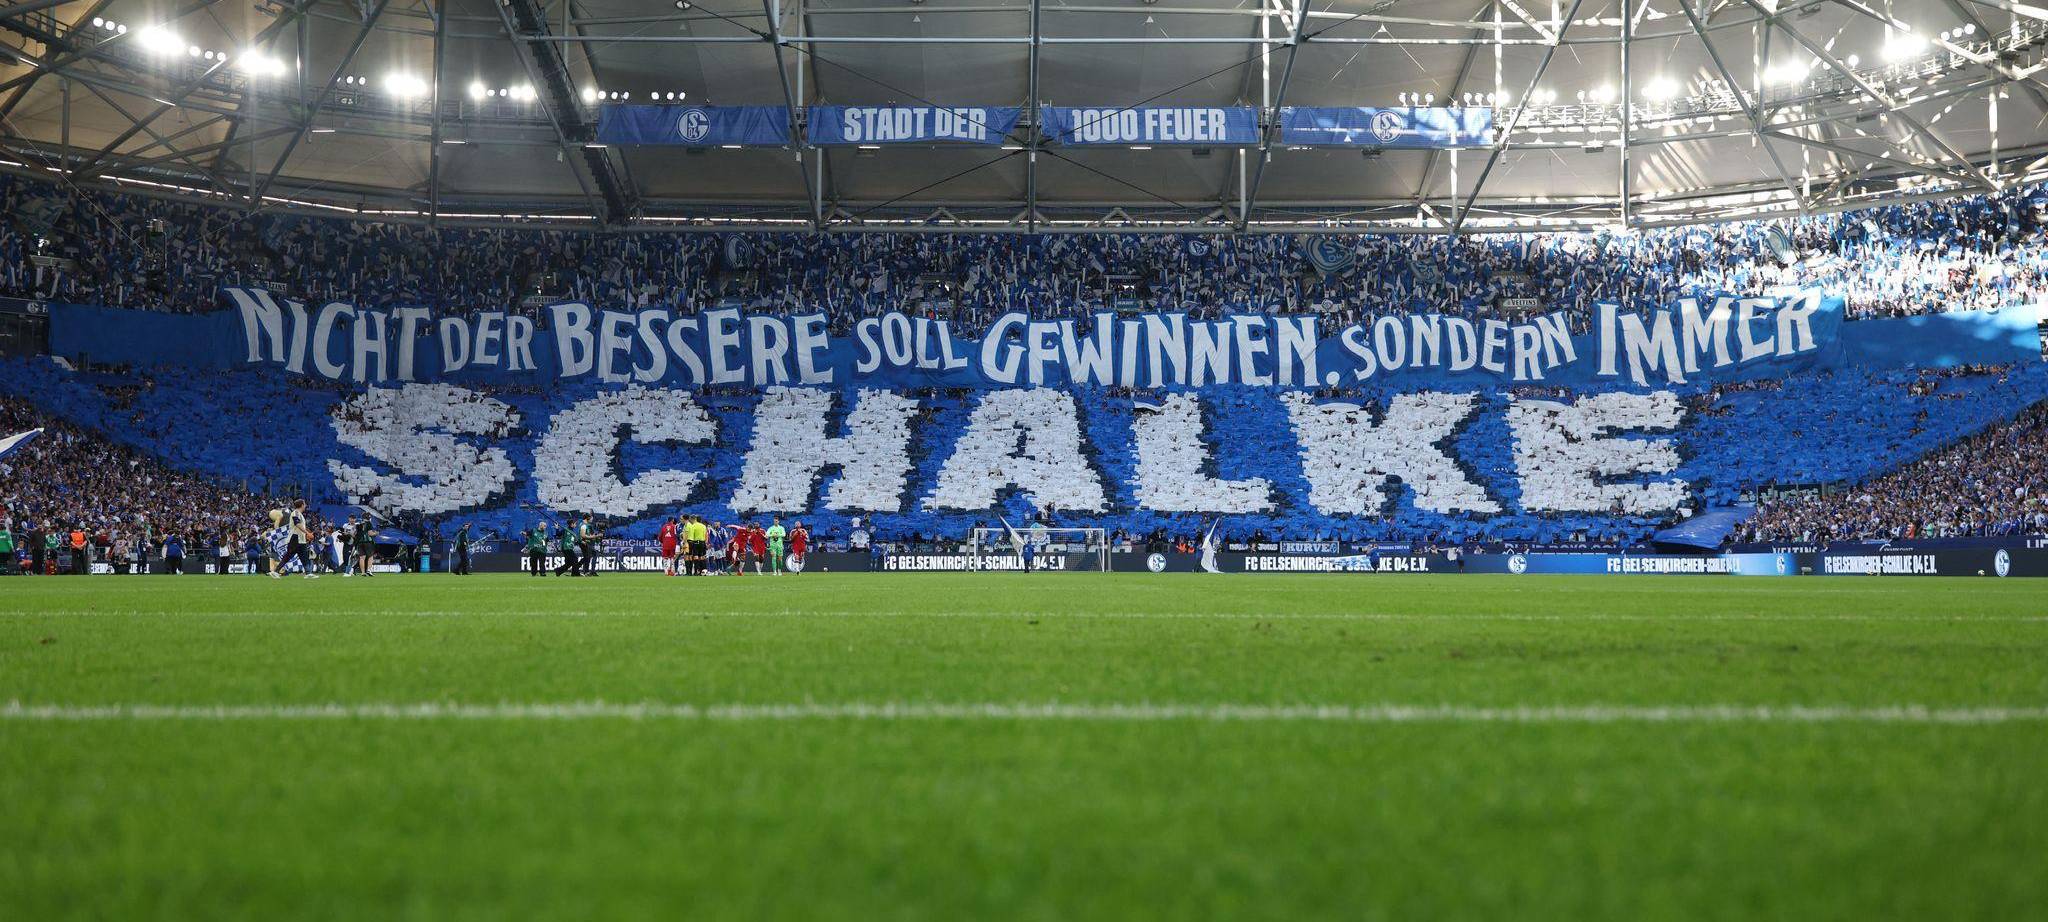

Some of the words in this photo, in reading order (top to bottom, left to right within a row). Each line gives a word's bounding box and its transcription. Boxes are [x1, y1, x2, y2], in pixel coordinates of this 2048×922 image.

[844, 107, 928, 141] STADT
[934, 108, 986, 139] DER
[1072, 109, 1138, 142] 1000
[1145, 109, 1226, 141] FEUER
[224, 288, 430, 381] NICHT
[440, 312, 537, 372] DER
[549, 303, 833, 384] BESSERE
[856, 312, 968, 373] SOLL
[1341, 312, 1577, 380] SONDERN
[1596, 285, 1822, 386] IMMER
[327, 384, 1690, 516] SCHALKE
[1286, 543, 1330, 552] KURVE
[899, 556, 1031, 570] GELSENKIRCHEN-SCHALK
[1245, 556, 1258, 571] FC
[1394, 557, 1409, 571] 04
[1411, 557, 1429, 571] E.V.
[1607, 557, 1620, 572] FC
